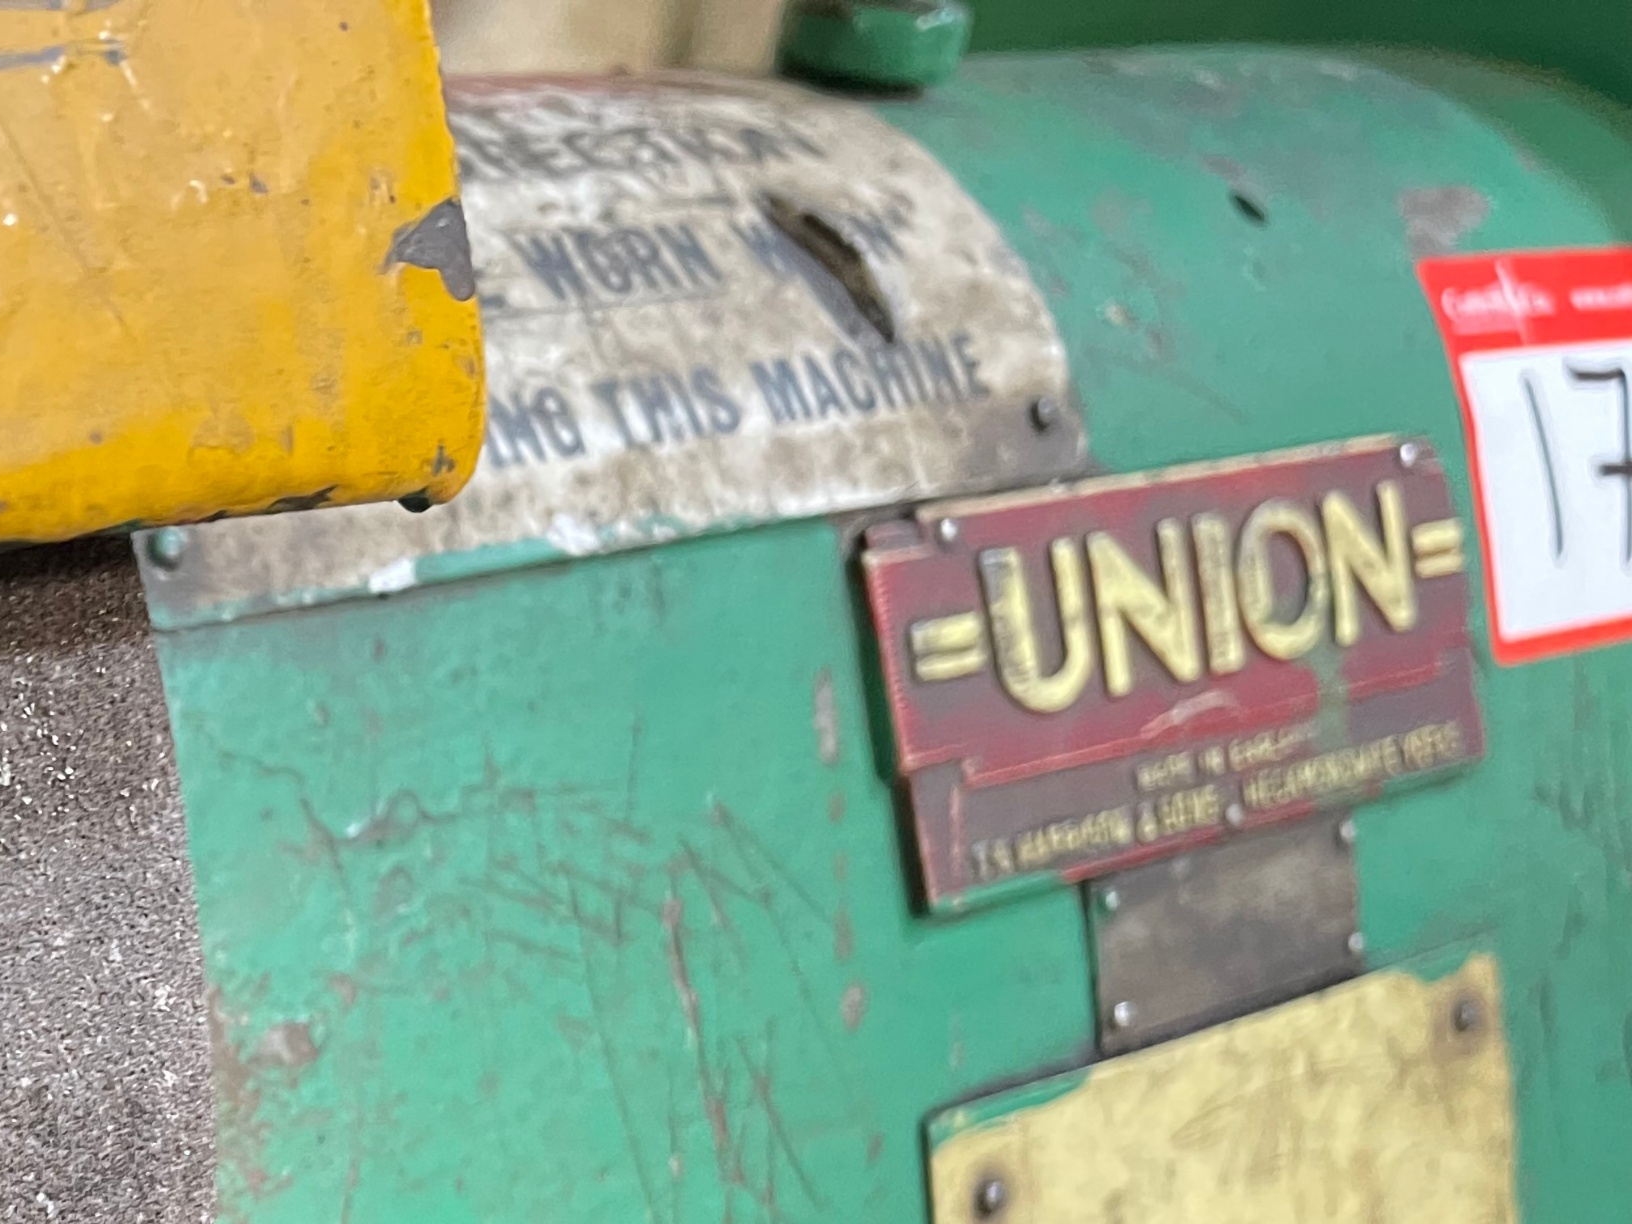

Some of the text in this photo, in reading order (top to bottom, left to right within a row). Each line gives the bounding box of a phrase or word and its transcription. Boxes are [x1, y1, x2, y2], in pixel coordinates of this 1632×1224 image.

[508, 216, 724, 302] WORN
[592, 364, 741, 443] THIS
[749, 331, 990, 424] MACHINE
